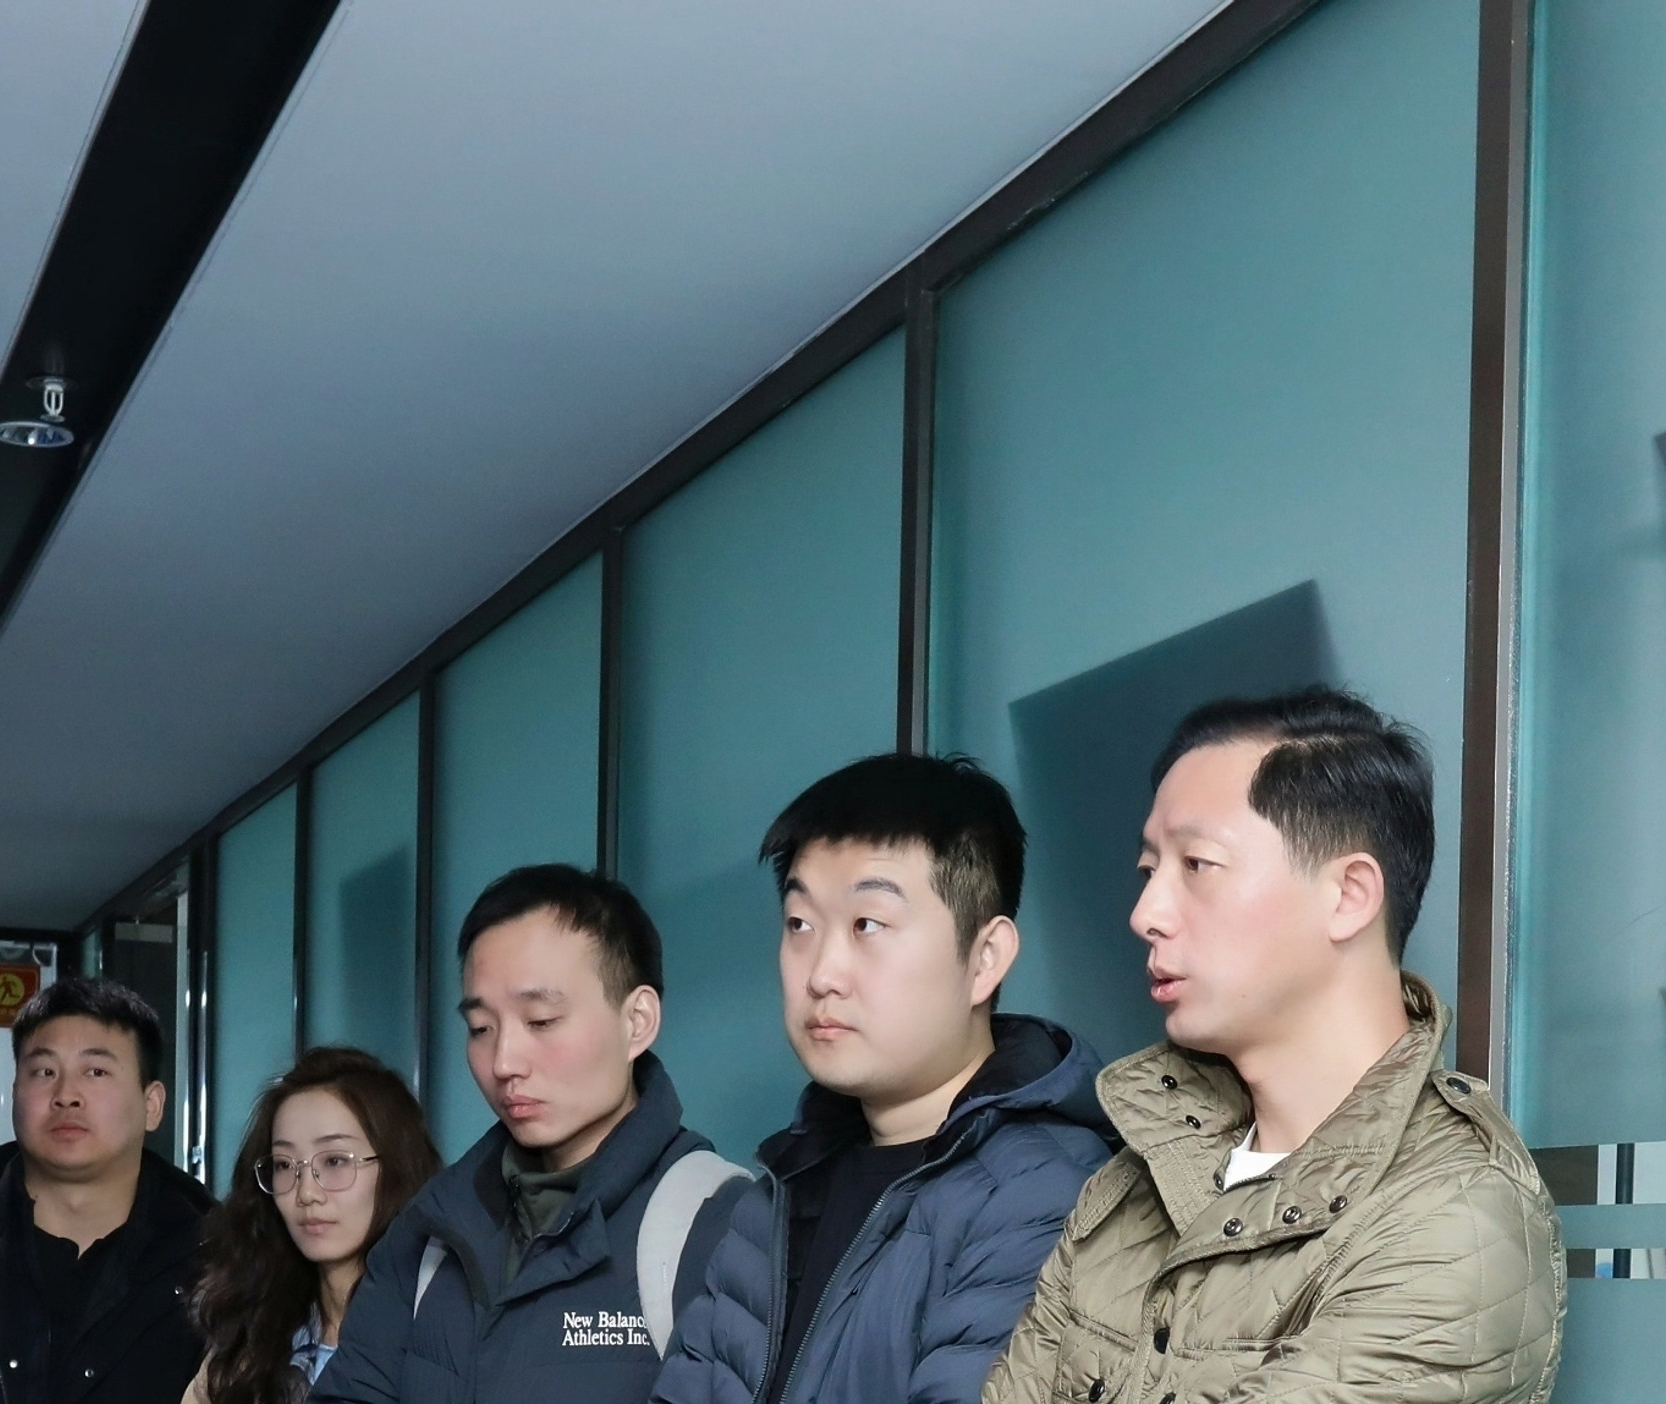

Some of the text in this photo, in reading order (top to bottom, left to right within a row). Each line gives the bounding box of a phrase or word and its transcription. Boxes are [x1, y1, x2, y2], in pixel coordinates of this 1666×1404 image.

[563, 1311, 647, 1328] New Balanc
[562, 1328, 650, 1346] Athletics Inc.
